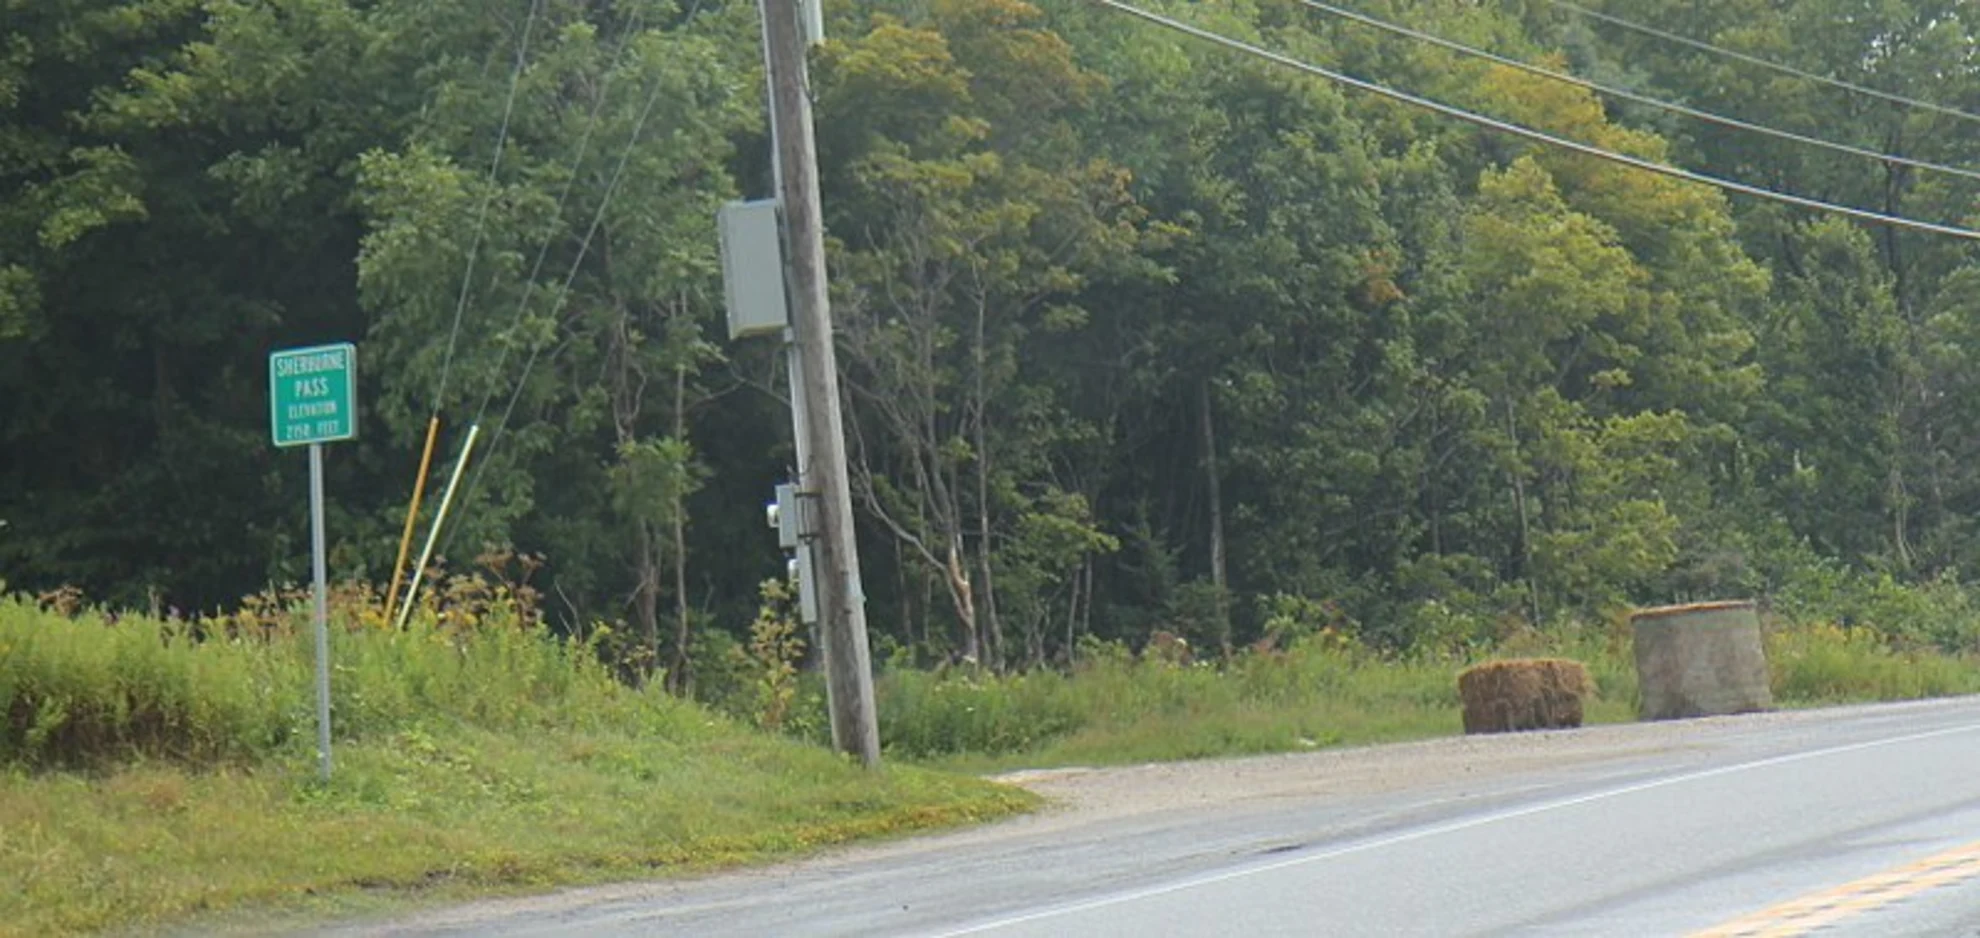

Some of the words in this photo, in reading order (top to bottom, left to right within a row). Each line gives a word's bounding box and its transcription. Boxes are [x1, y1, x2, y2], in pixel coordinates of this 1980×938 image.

[277, 351, 345, 377] SHERBURNE
[295, 376, 329, 398] PASS
[288, 401, 337, 419] ELEVATION
[316, 420, 339, 435] FEET
